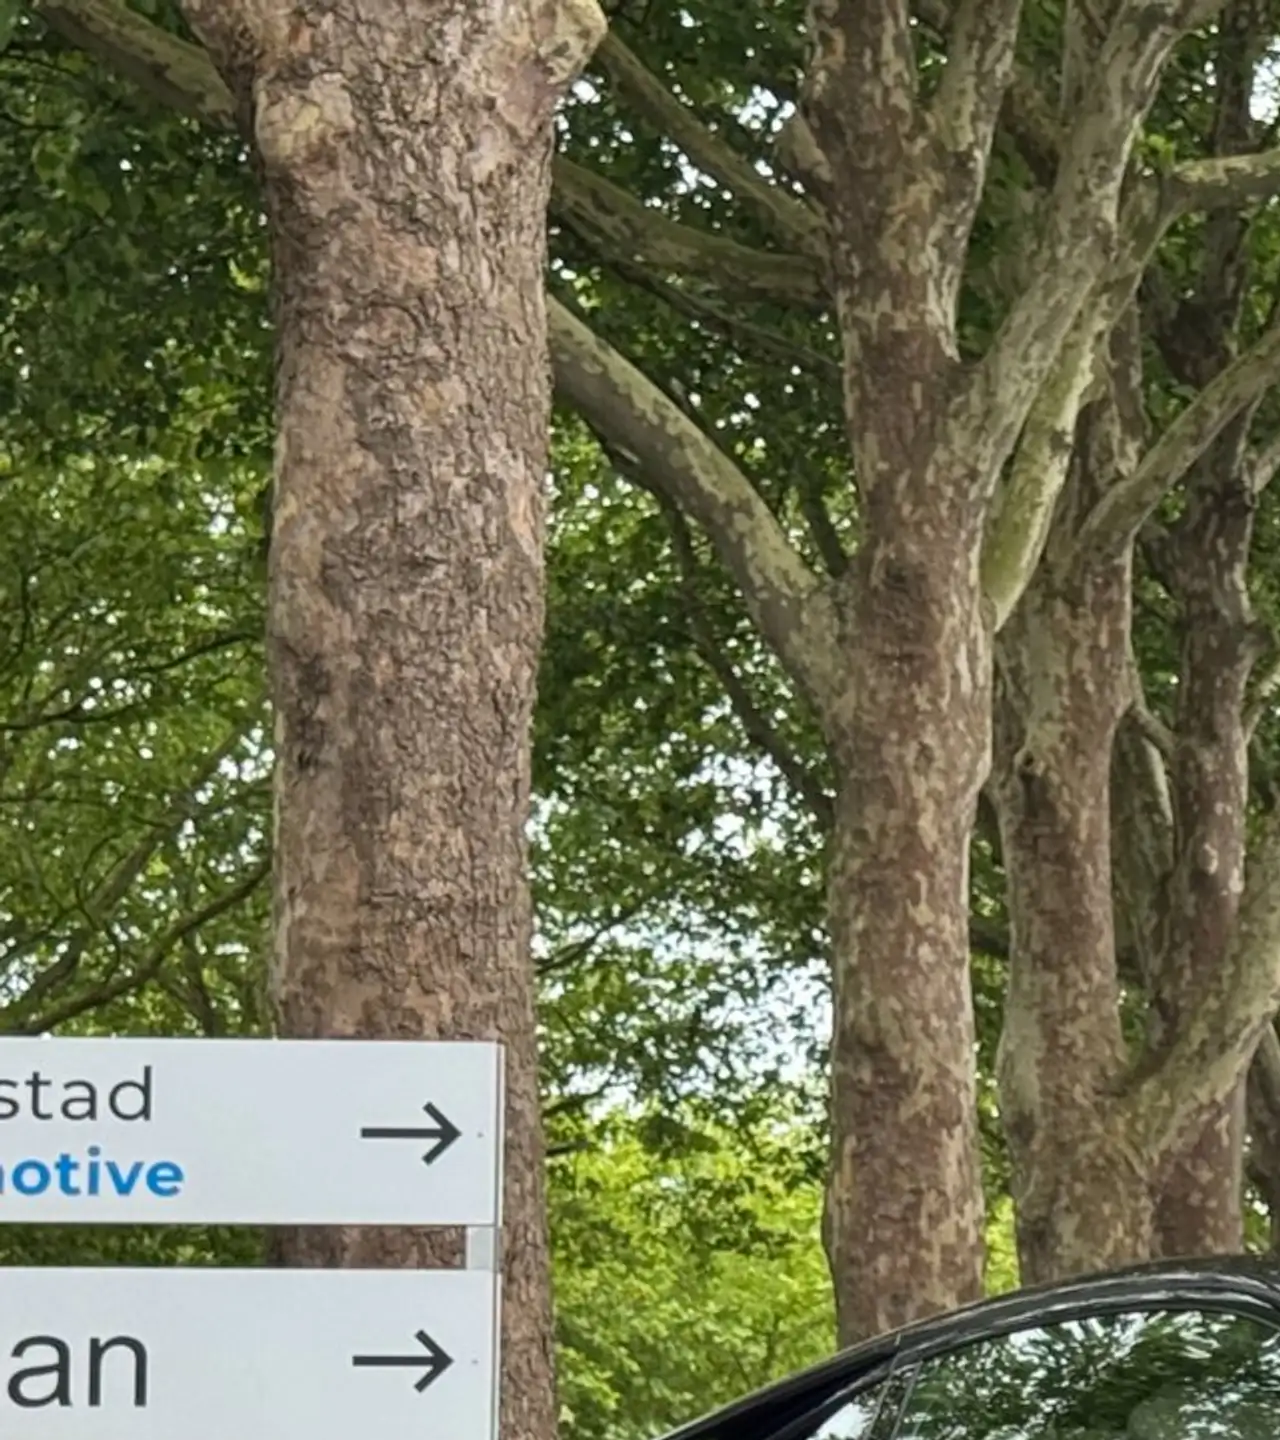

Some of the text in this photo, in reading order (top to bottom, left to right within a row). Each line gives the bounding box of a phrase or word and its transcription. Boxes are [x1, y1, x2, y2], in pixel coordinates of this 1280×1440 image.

[0, 1065, 153, 1121] stad
[0, 1145, 185, 1197] otive
[7, 1335, 148, 1408] an
